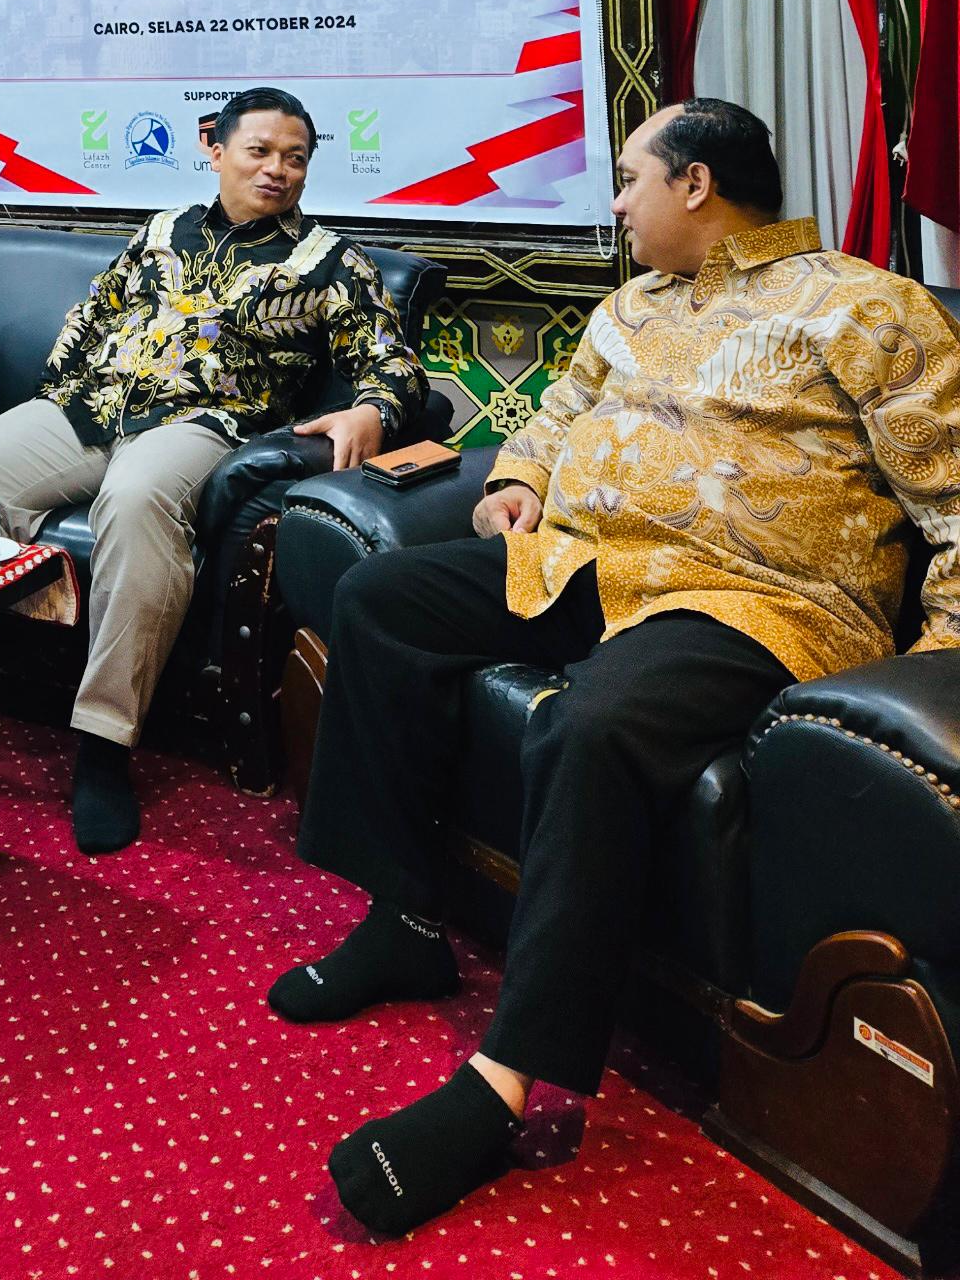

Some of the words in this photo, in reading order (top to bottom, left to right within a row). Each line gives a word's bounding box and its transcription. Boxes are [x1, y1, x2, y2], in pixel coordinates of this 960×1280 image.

[93, 22, 144, 36] CAIRO,
[148, 19, 206, 34] SELASA
[210, 19, 228, 32] 22
[232, 17, 309, 31] OKTOBER
[314, 15, 357, 29] 2024
[352, 163, 381, 174] Books
